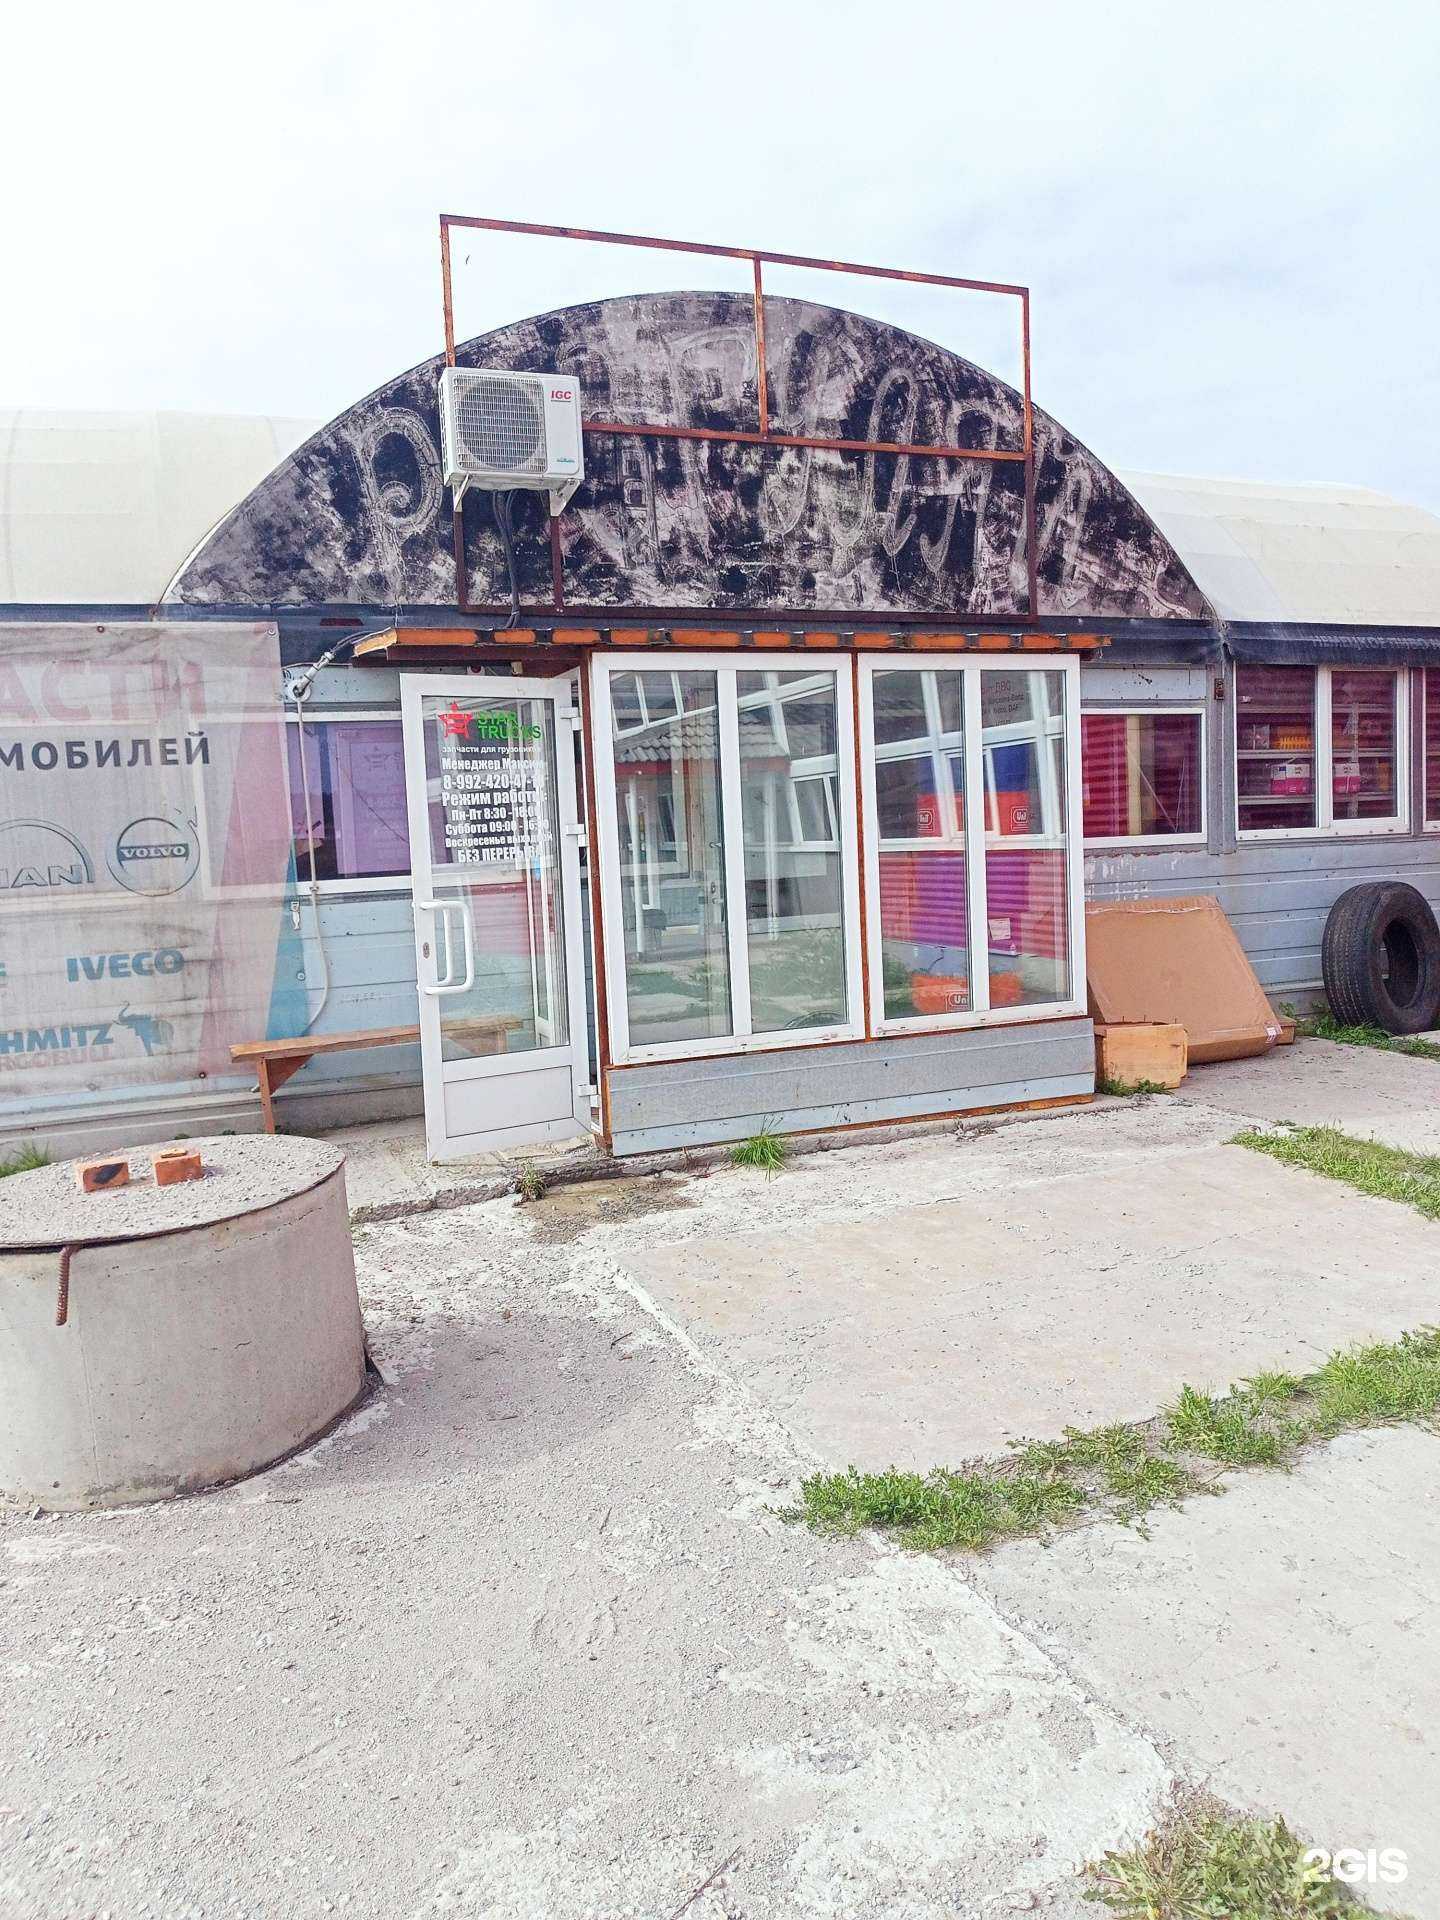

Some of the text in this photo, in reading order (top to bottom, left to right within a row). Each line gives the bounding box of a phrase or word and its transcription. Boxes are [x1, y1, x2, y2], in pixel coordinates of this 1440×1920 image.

[551, 390, 572, 400] IGC
[477, 710, 518, 725] STAR
[0, 731, 210, 771] МОБИЛЕЙ
[480, 746, 496, 755] для
[498, 746, 541, 755] грузовико
[442, 757, 500, 771] Менеджер
[442, 789, 548, 807] Режим работ:
[452, 808, 482, 821] Пн-Пт
[484, 806, 507, 819] 8:30
[445, 822, 488, 836] Суббота
[445, 836, 506, 848] Воскресенье
[123, 846, 187, 858] VOLVO
[457, 849, 480, 863] БЕЗ
[66, 950, 184, 983] IVECO
